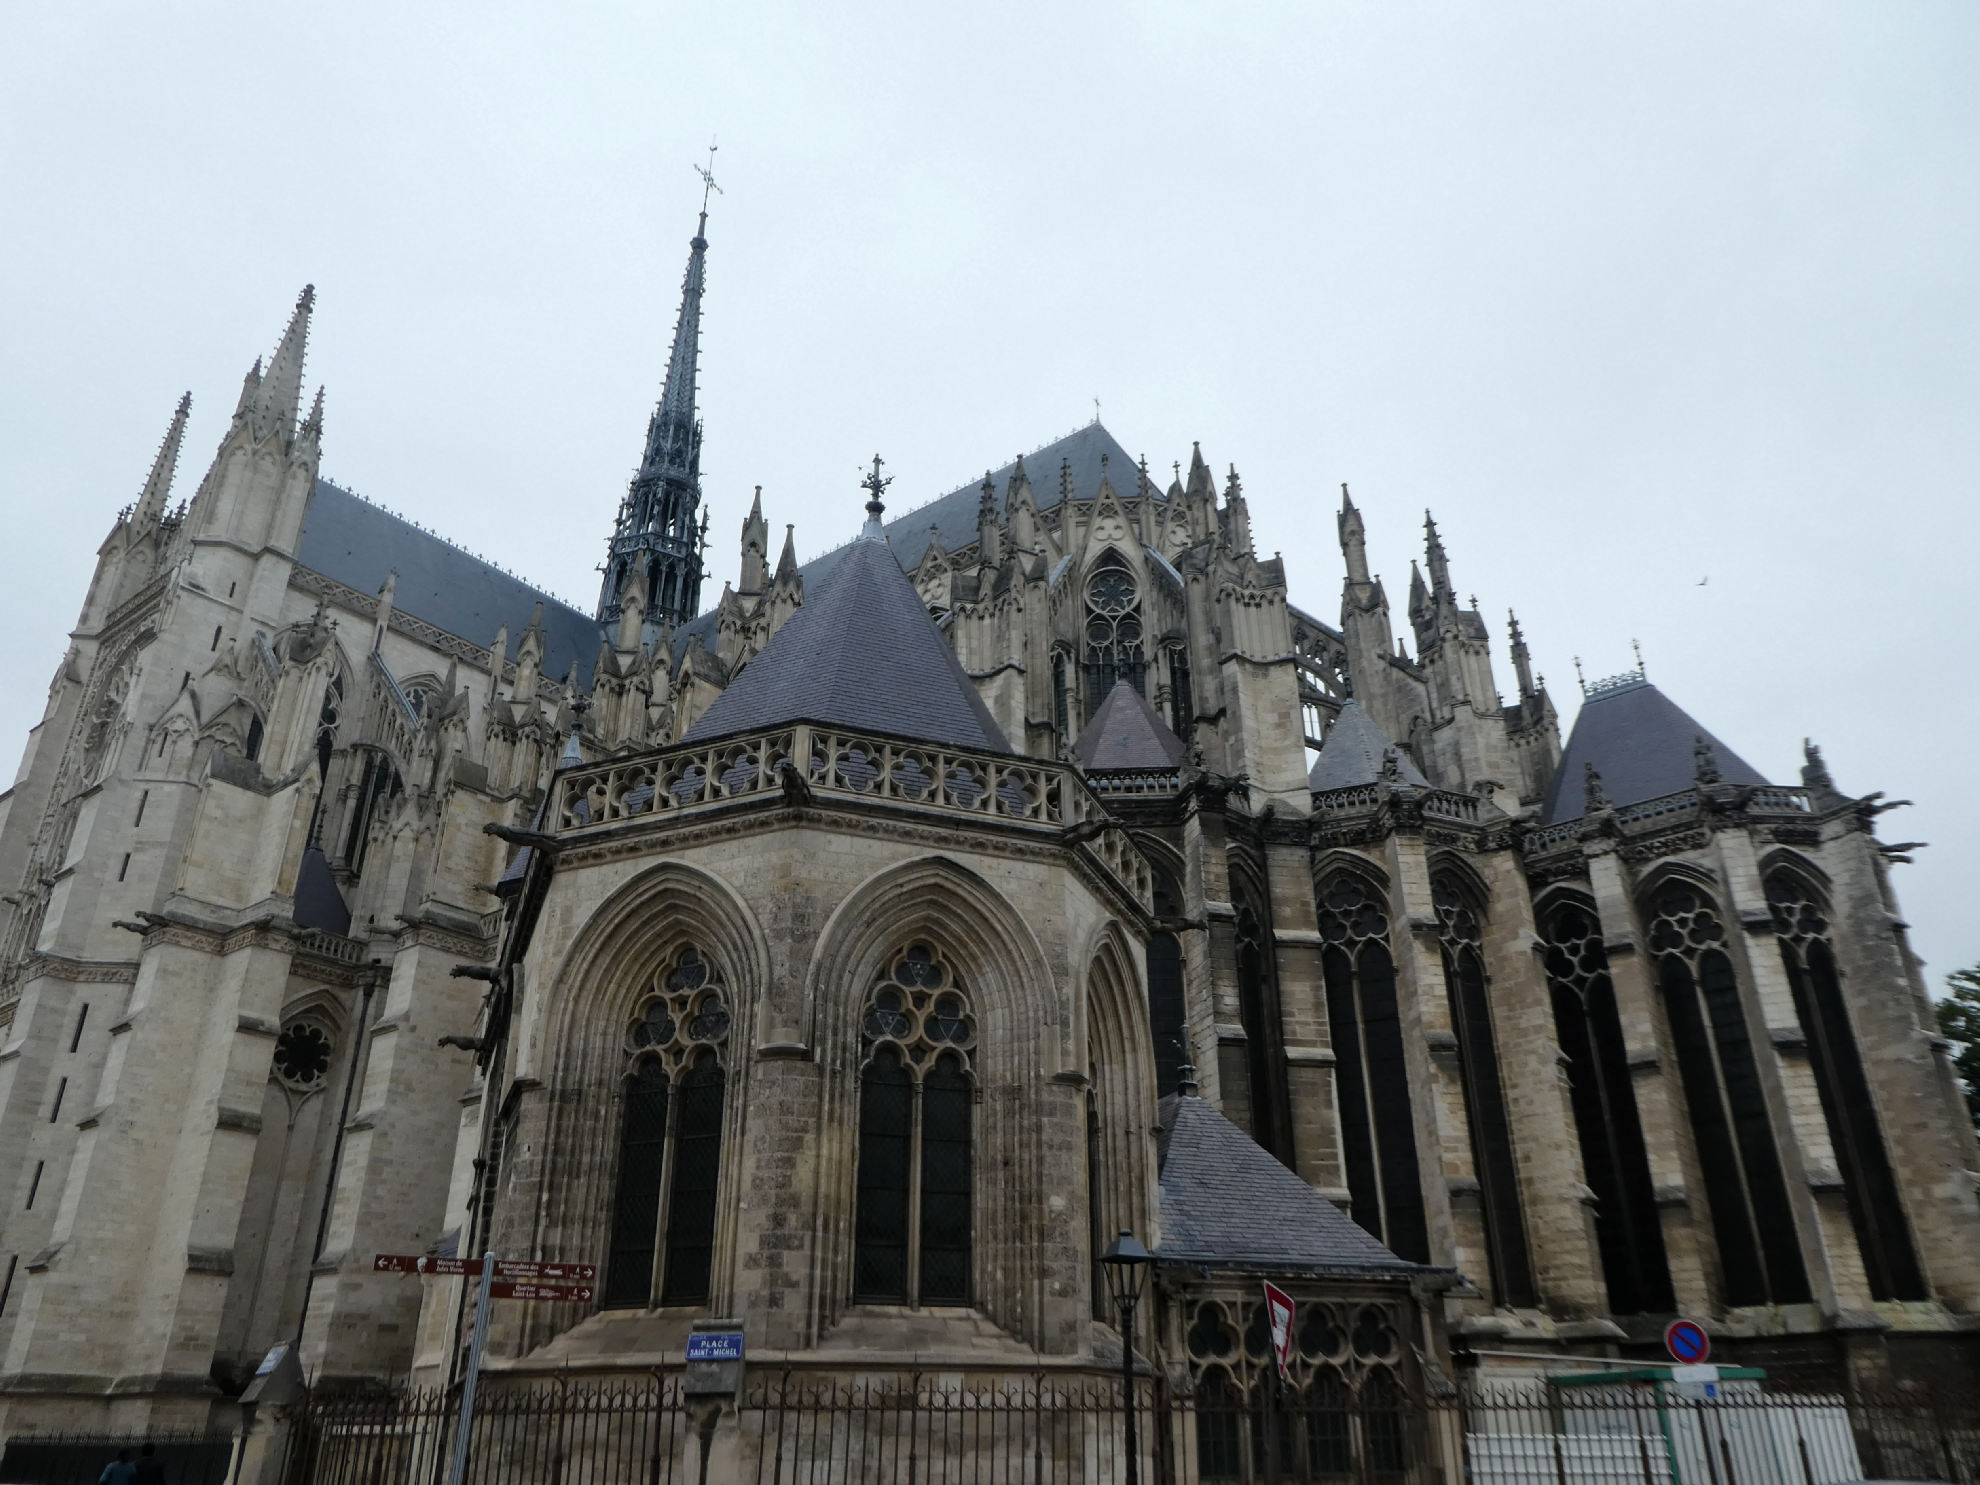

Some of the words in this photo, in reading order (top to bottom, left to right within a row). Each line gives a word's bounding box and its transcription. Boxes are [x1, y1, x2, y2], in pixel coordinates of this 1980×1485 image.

[436, 1258, 455, 1266] Maison
[455, 1259, 463, 1267] de
[530, 1262, 539, 1270] des
[436, 1265, 449, 1273] Jules
[449, 1266, 465, 1274] Verne
[515, 1284, 536, 1292] Quartier
[700, 1340, 729, 1348] PLACE
